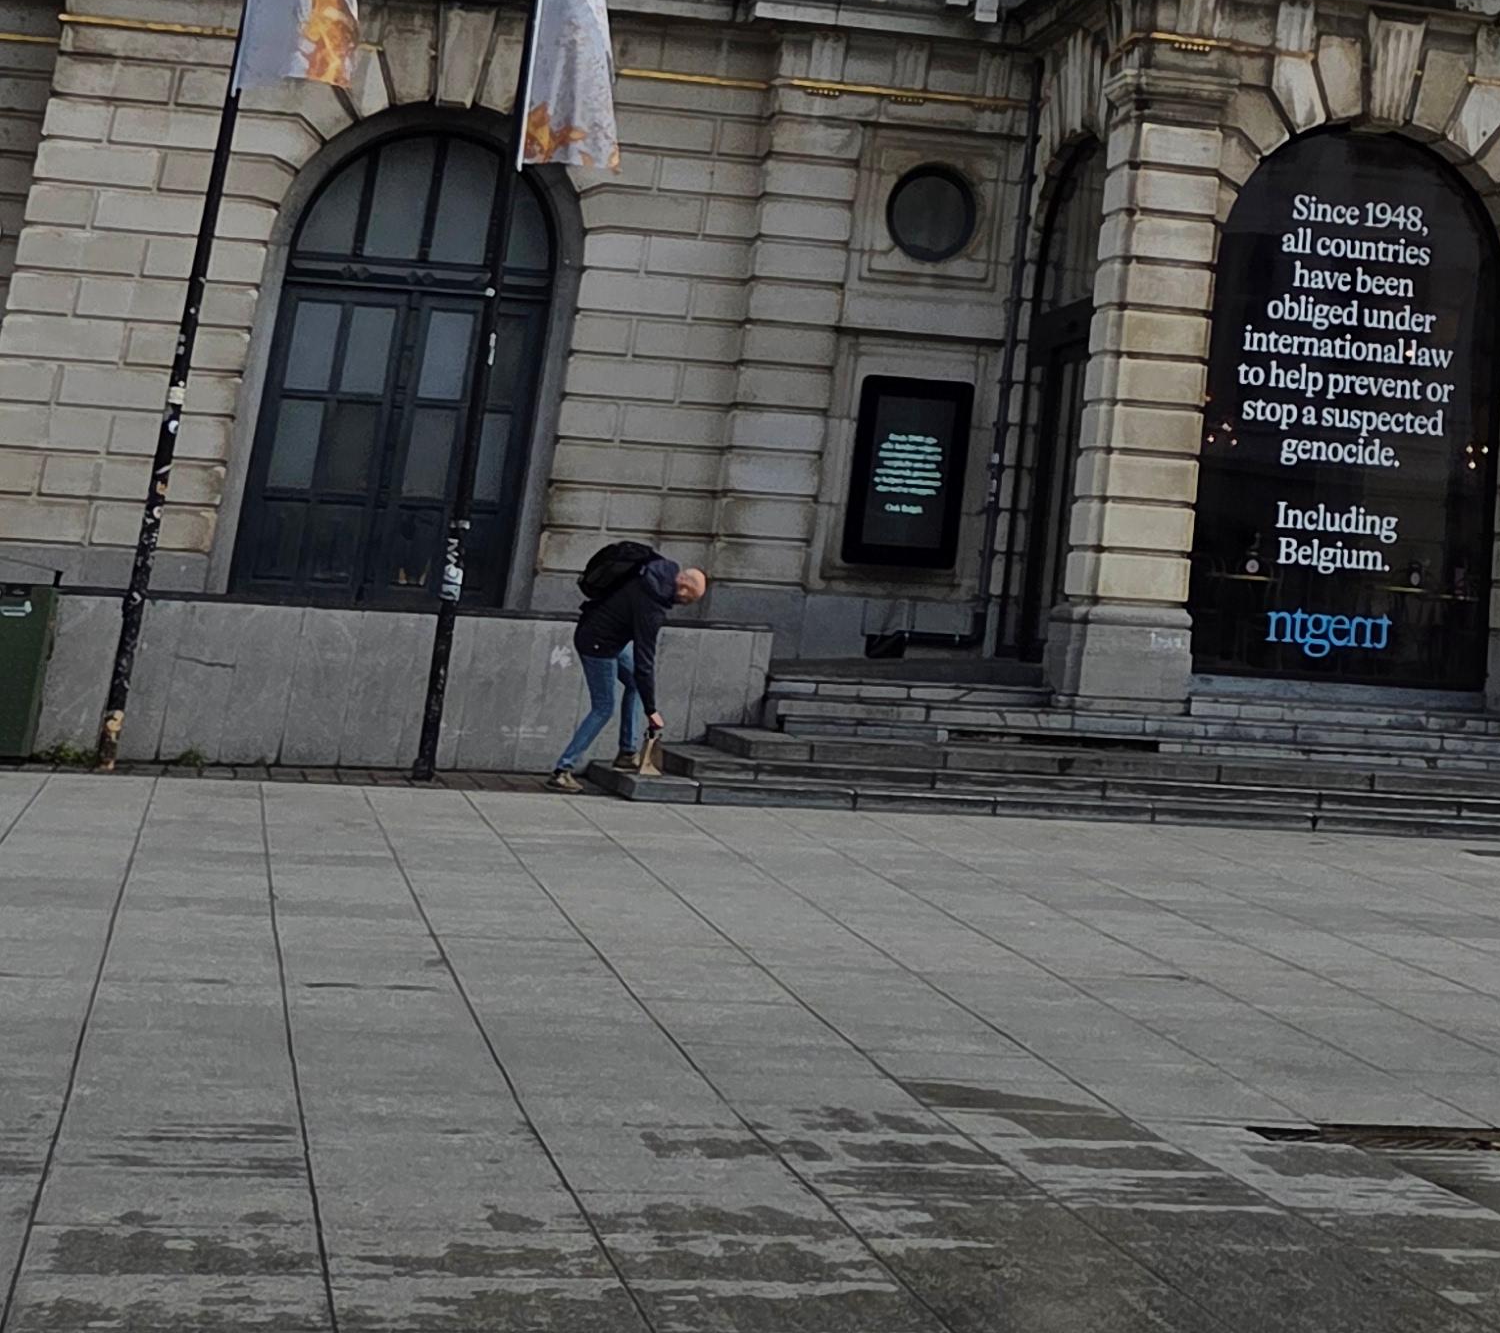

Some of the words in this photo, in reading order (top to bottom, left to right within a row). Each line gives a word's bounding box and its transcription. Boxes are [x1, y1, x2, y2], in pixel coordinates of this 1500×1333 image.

[1293, 194, 1359, 226] Since
[1364, 202, 1429, 237] 1948,
[1283, 227, 1311, 254] all
[1317, 237, 1431, 265] countries
[1293, 261, 1351, 293] have
[1356, 266, 1414, 298] been
[1267, 293, 1357, 330] obliged
[1363, 303, 1436, 333] under
[1243, 325, 1403, 363] international
[1409, 340, 1453, 368] law
[1238, 361, 1265, 386] to
[1269, 360, 1323, 397] help
[1327, 373, 1422, 400] prevent
[1426, 379, 1454, 402] or
[1243, 400, 1297, 429] stop
[1302, 406, 1317, 425] a
[1322, 406, 1444, 437] suspected
[1280, 437, 1400, 468] genocide.
[1276, 502, 1398, 543] Including
[1277, 537, 1390, 573] Belgium.
